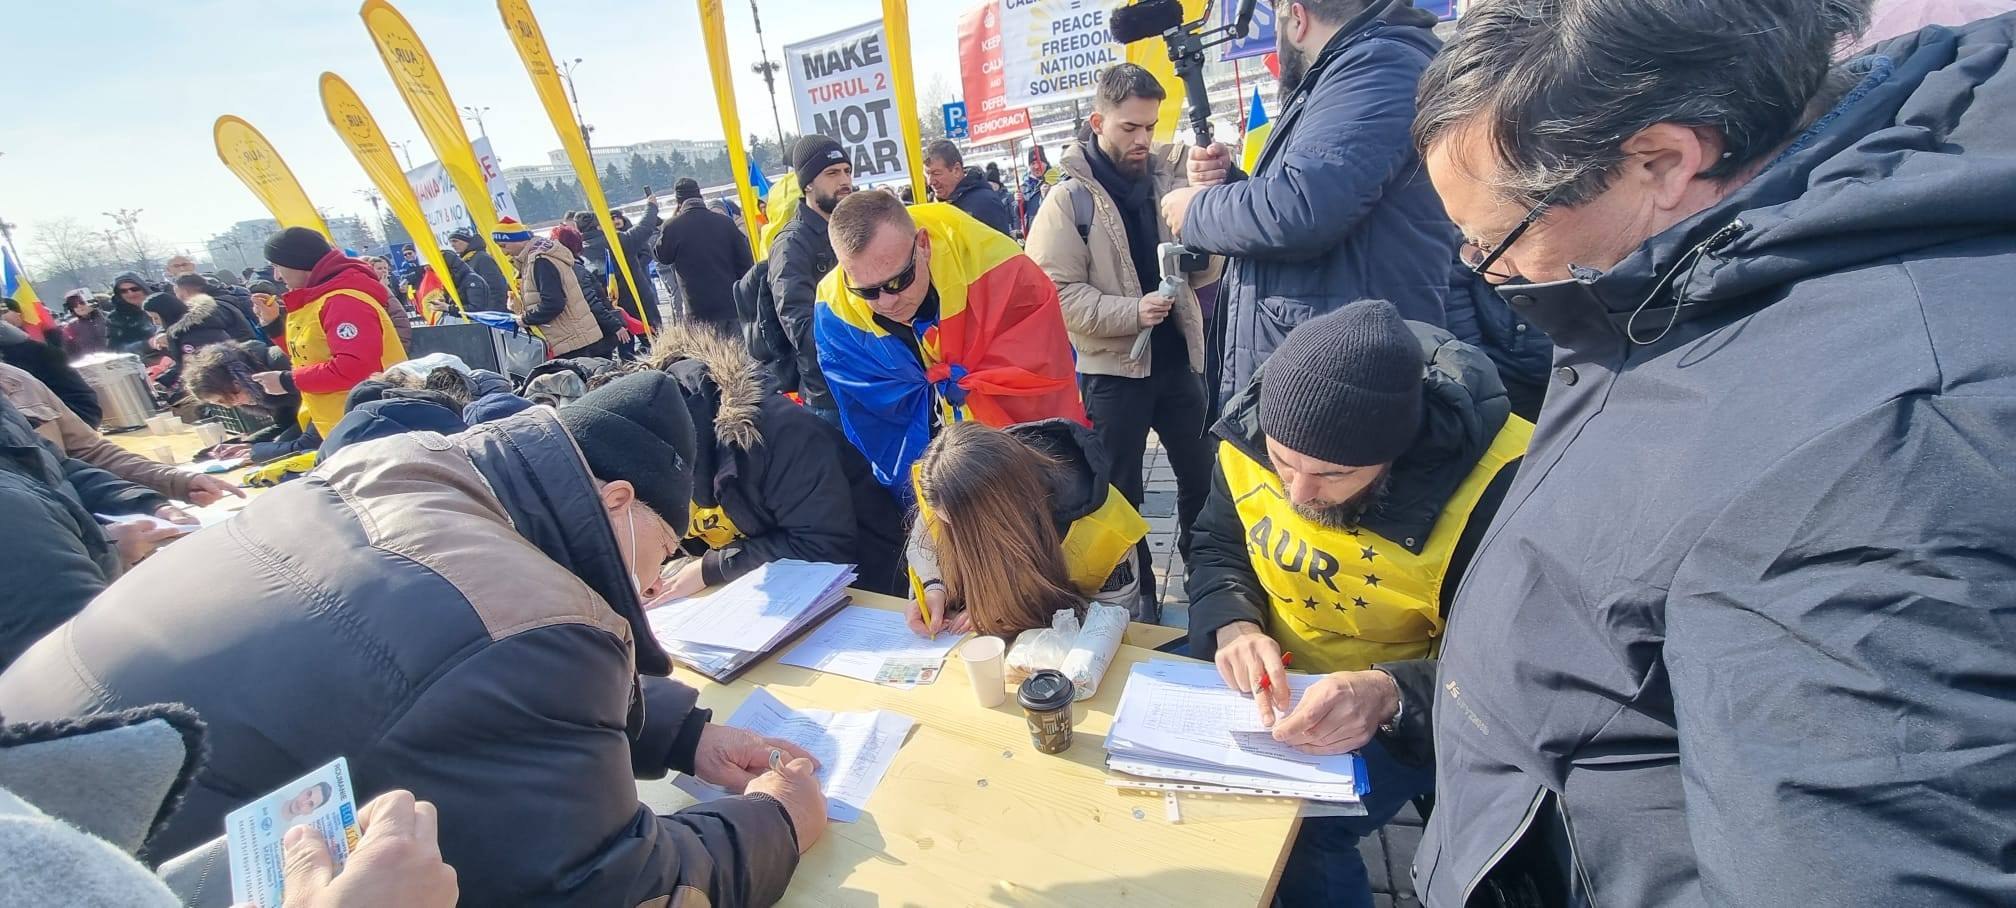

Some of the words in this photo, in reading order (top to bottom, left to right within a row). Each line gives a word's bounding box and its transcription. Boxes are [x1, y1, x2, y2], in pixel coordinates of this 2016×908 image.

[1052, 10, 1103, 35] PEACE
[802, 34, 883, 80] MAKE
[1040, 48, 1117, 75] NATIONAL
[808, 78, 869, 105] TURUL
[874, 72, 887, 91] 2
[813, 98, 891, 146] NOT
[949, 107, 962, 128] P
[973, 111, 1026, 135] DEMOCRACY
[844, 139, 902, 178] AR
[1250, 516, 1340, 593] AUR
